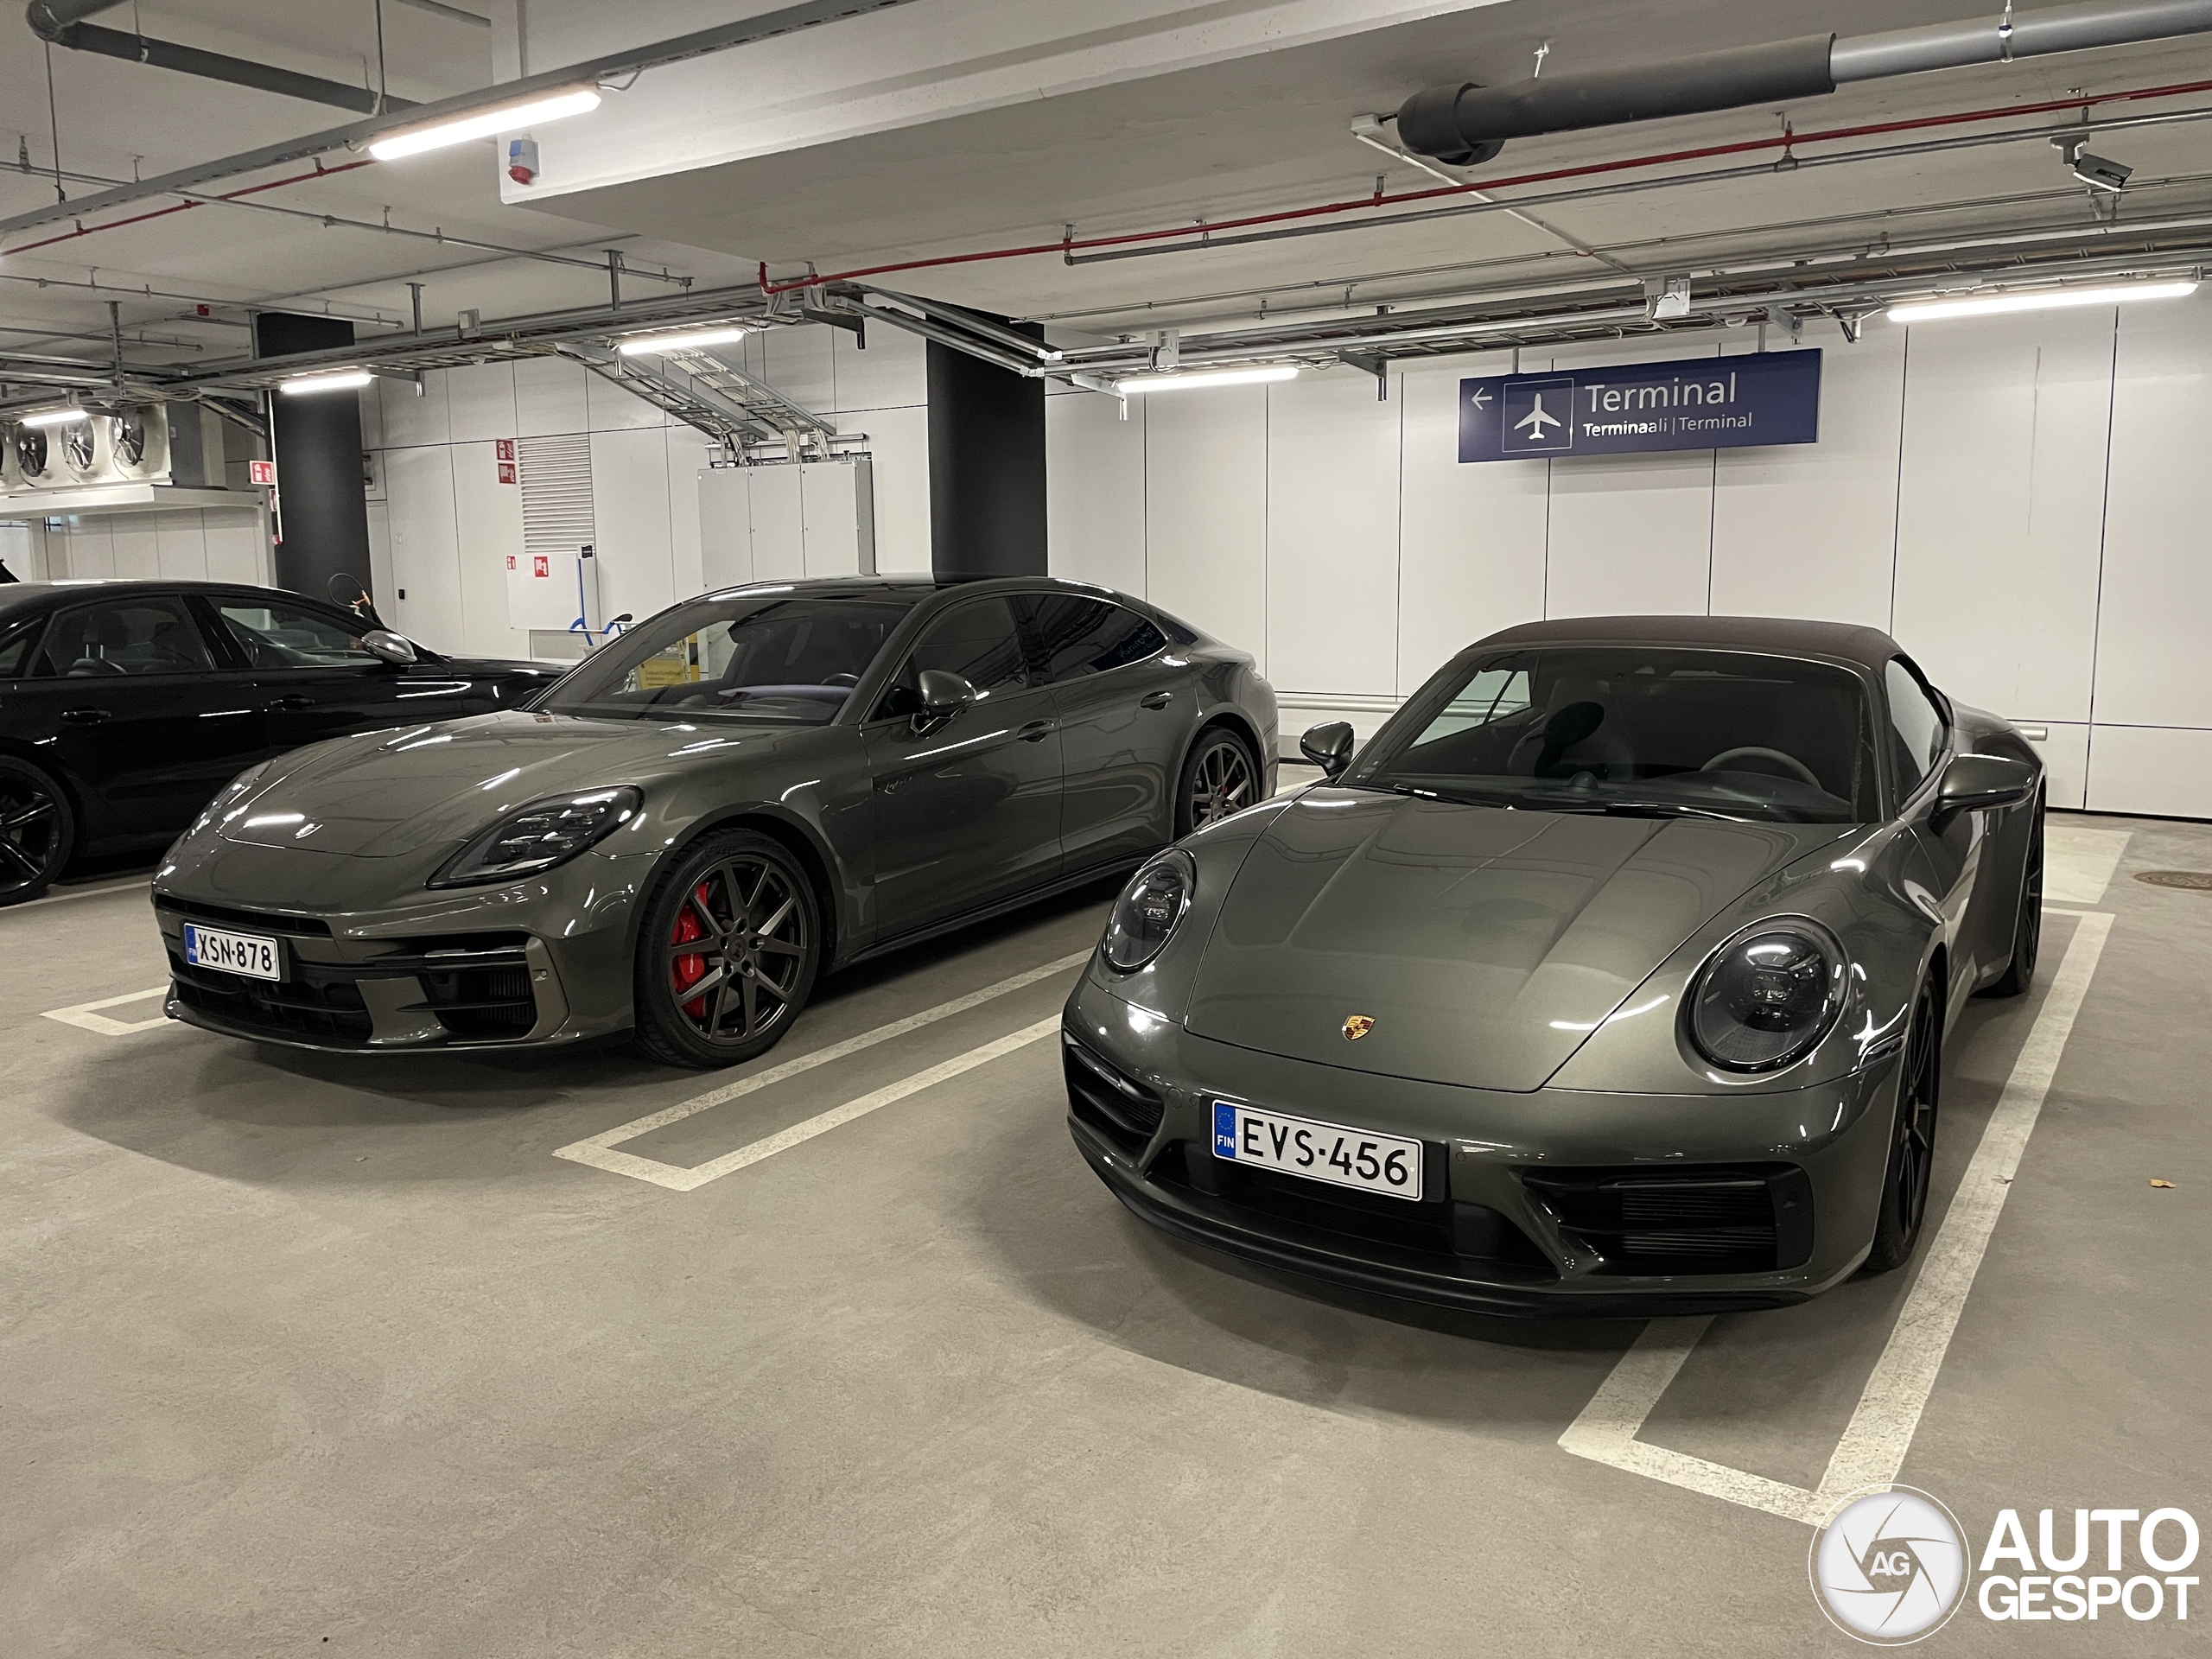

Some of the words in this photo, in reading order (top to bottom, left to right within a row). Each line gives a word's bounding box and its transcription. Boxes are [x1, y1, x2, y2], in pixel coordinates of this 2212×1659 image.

[1584, 372, 1737, 413] Terminal
[1583, 417, 1669, 437] Terminaali
[1679, 412, 1752, 432] Terminal
[1217, 1135, 1235, 1148] FIN
